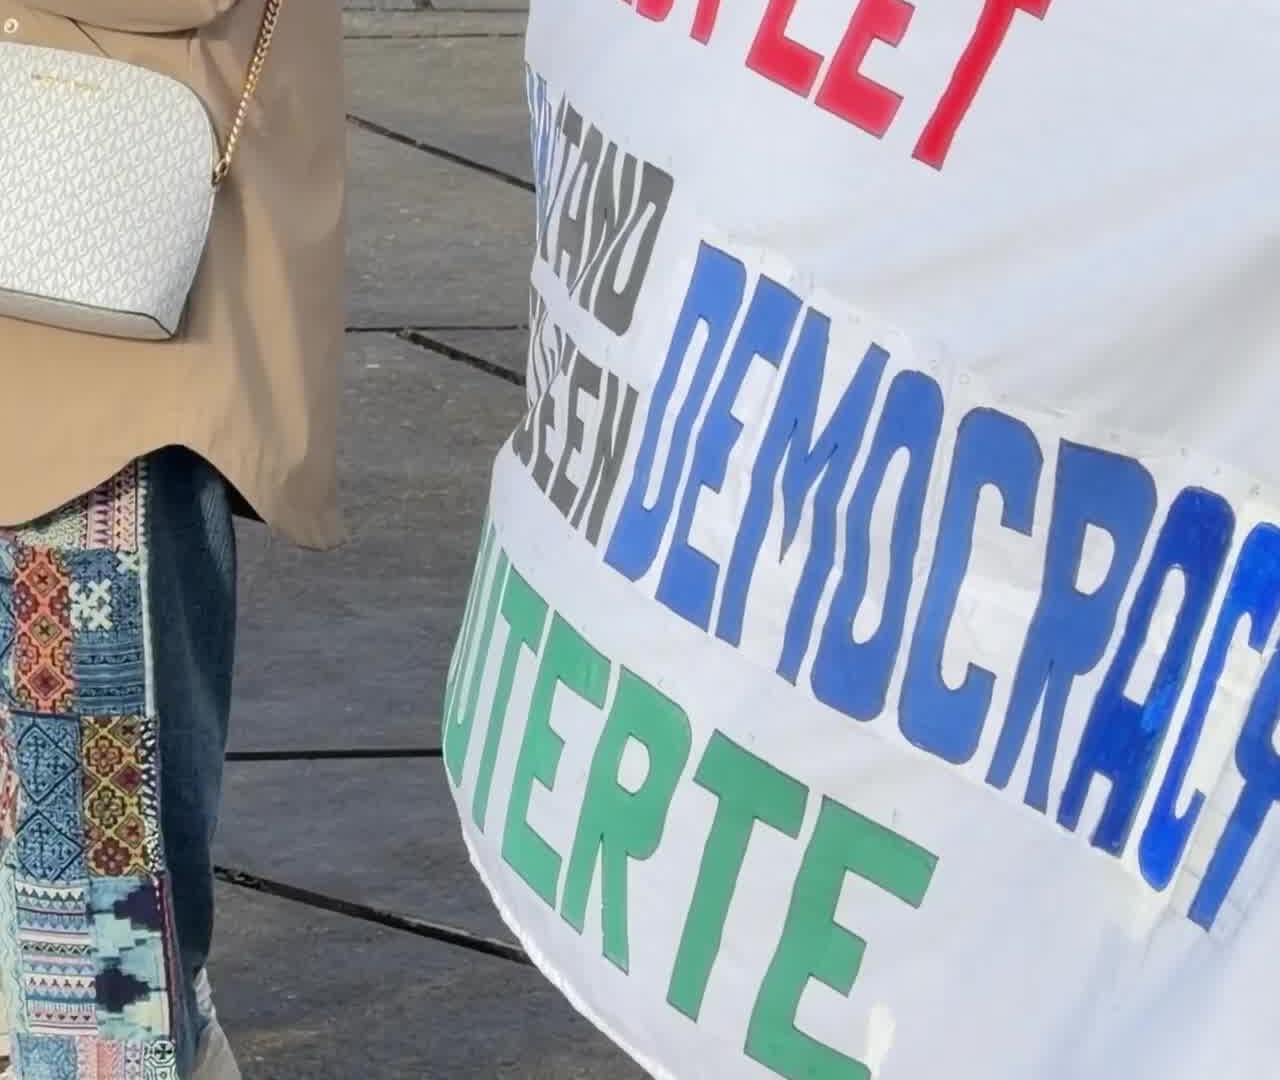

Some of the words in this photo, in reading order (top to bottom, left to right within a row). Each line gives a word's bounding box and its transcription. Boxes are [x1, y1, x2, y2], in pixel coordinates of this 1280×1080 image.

[540, 88, 674, 337] TAND
[441, 510, 940, 1080] UTERTE
[602, 239, 1280, 932] DEMOCRACY
